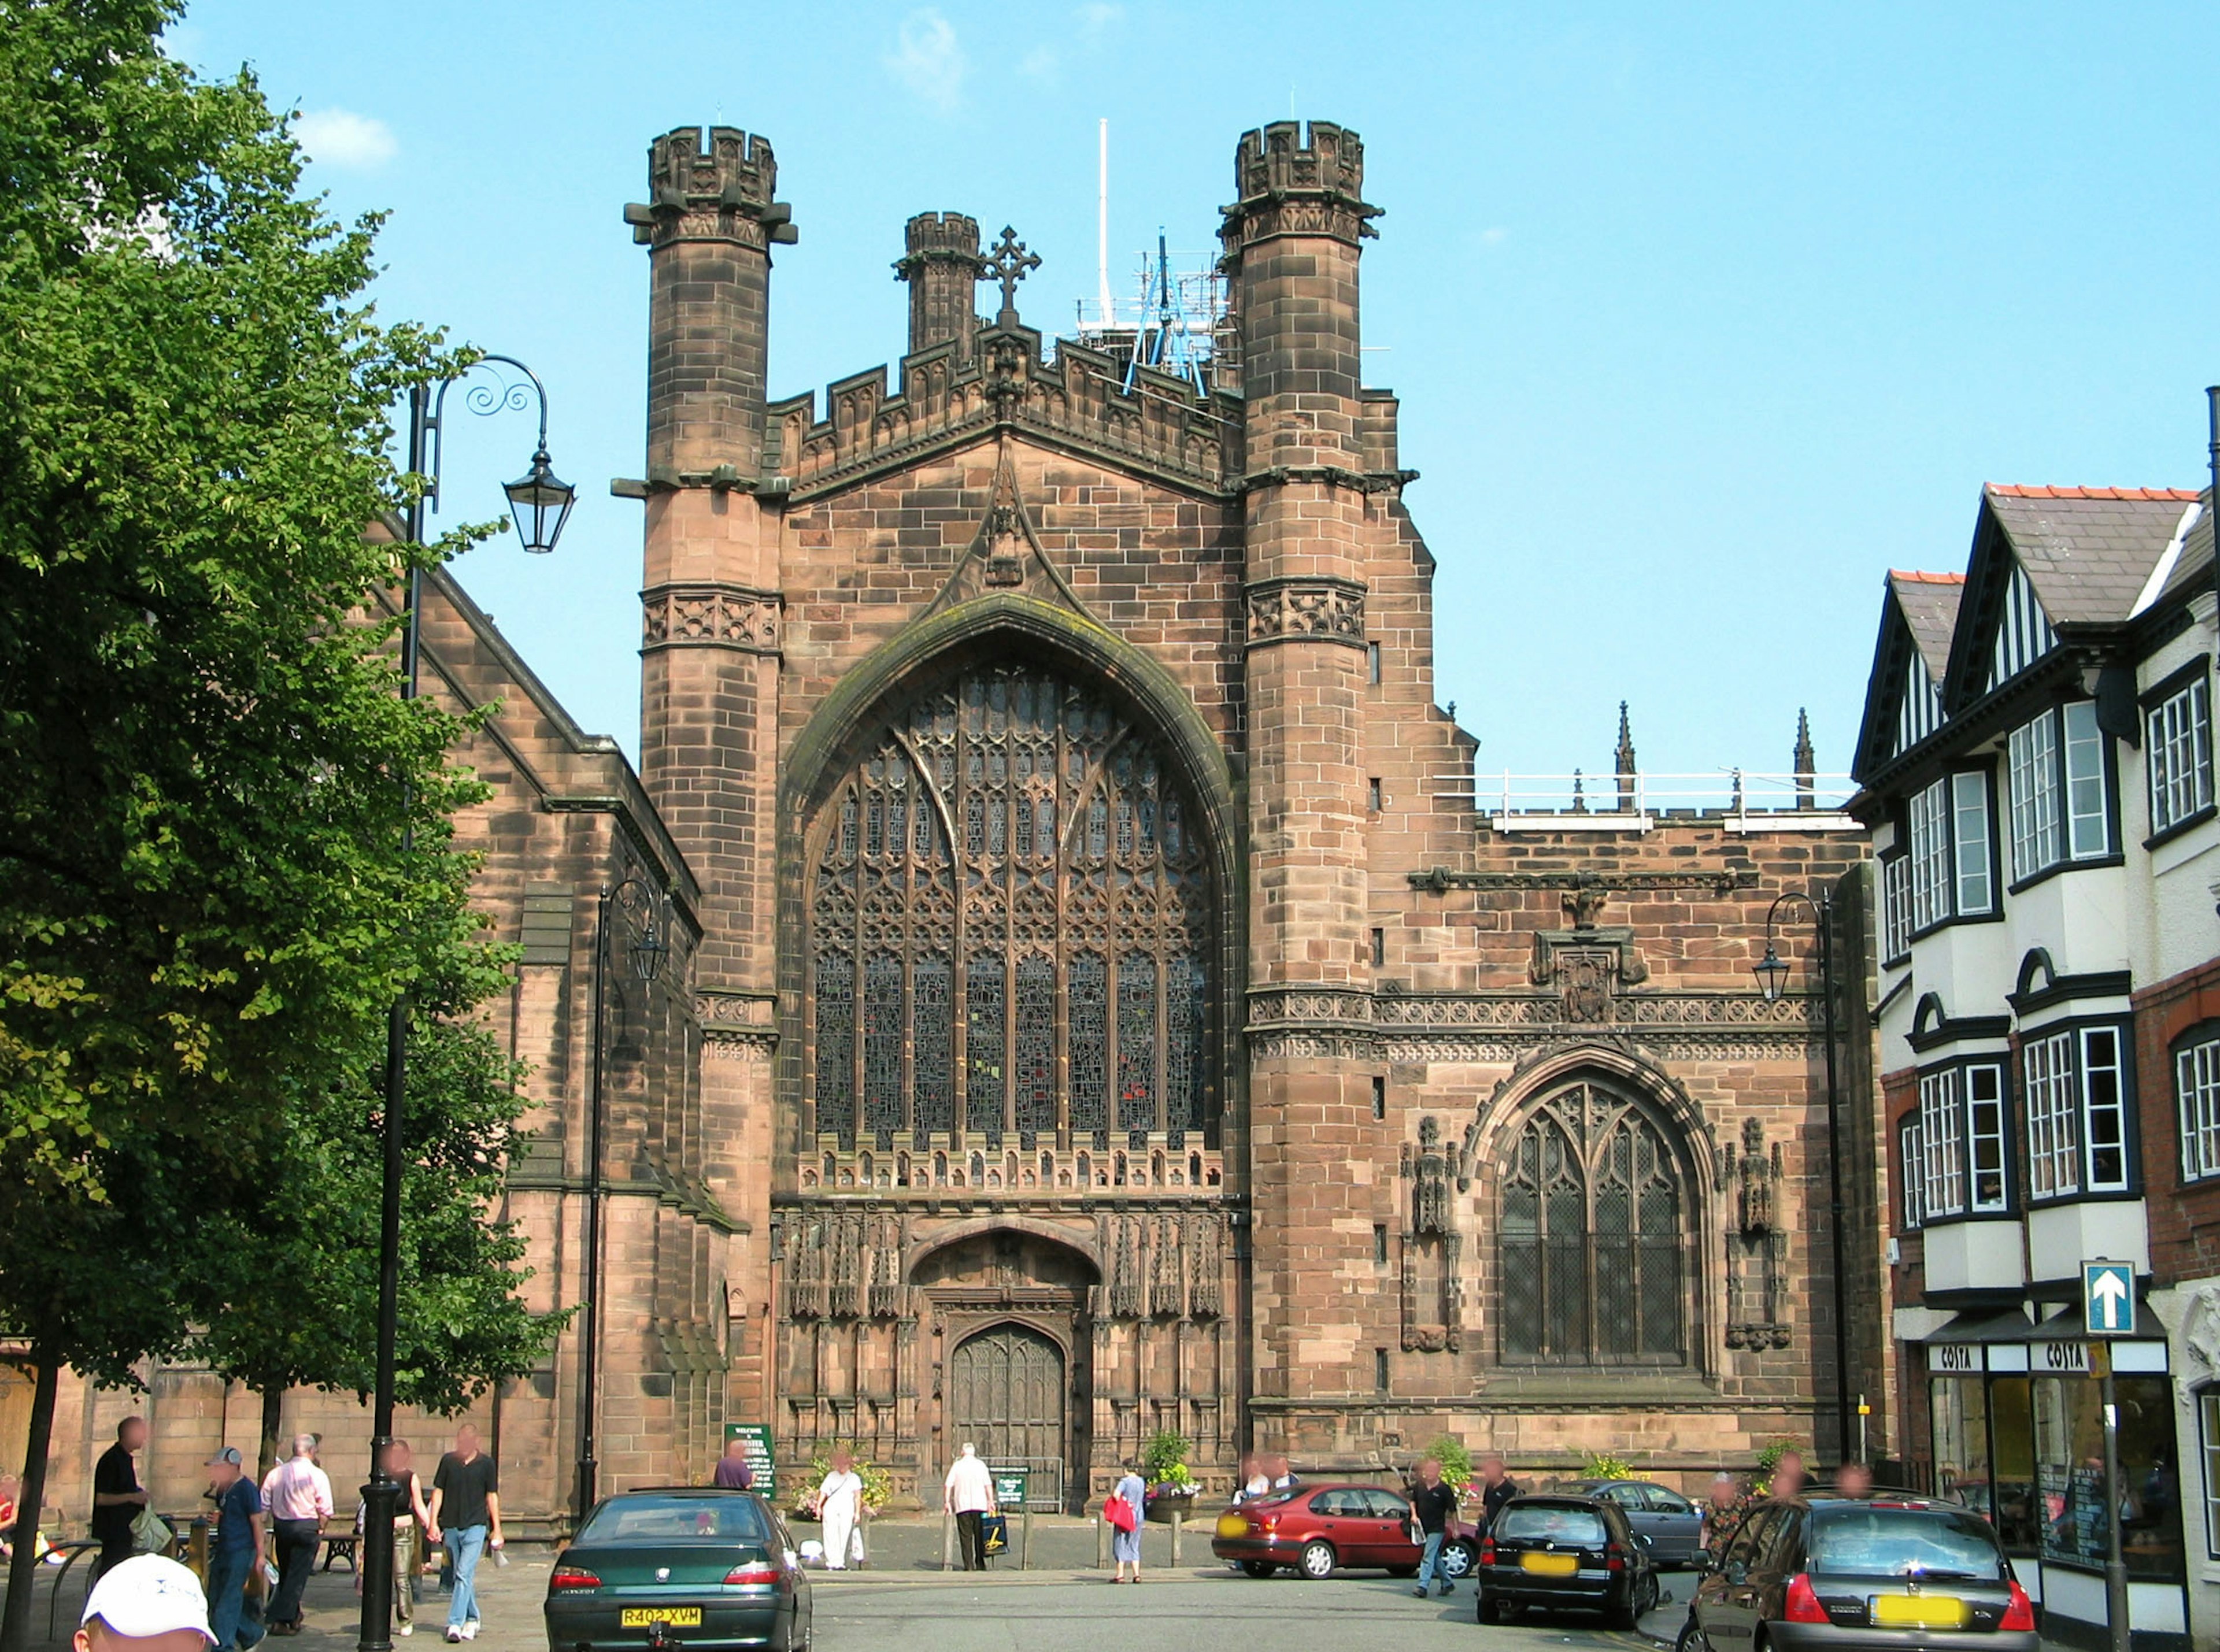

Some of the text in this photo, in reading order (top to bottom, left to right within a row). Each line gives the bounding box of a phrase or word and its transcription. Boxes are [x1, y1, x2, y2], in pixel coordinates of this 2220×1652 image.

[1941, 1346, 1971, 1370] COSTA
[2047, 1343, 2083, 1370] COSTA
[624, 1609, 698, 1624] R402 XVM
